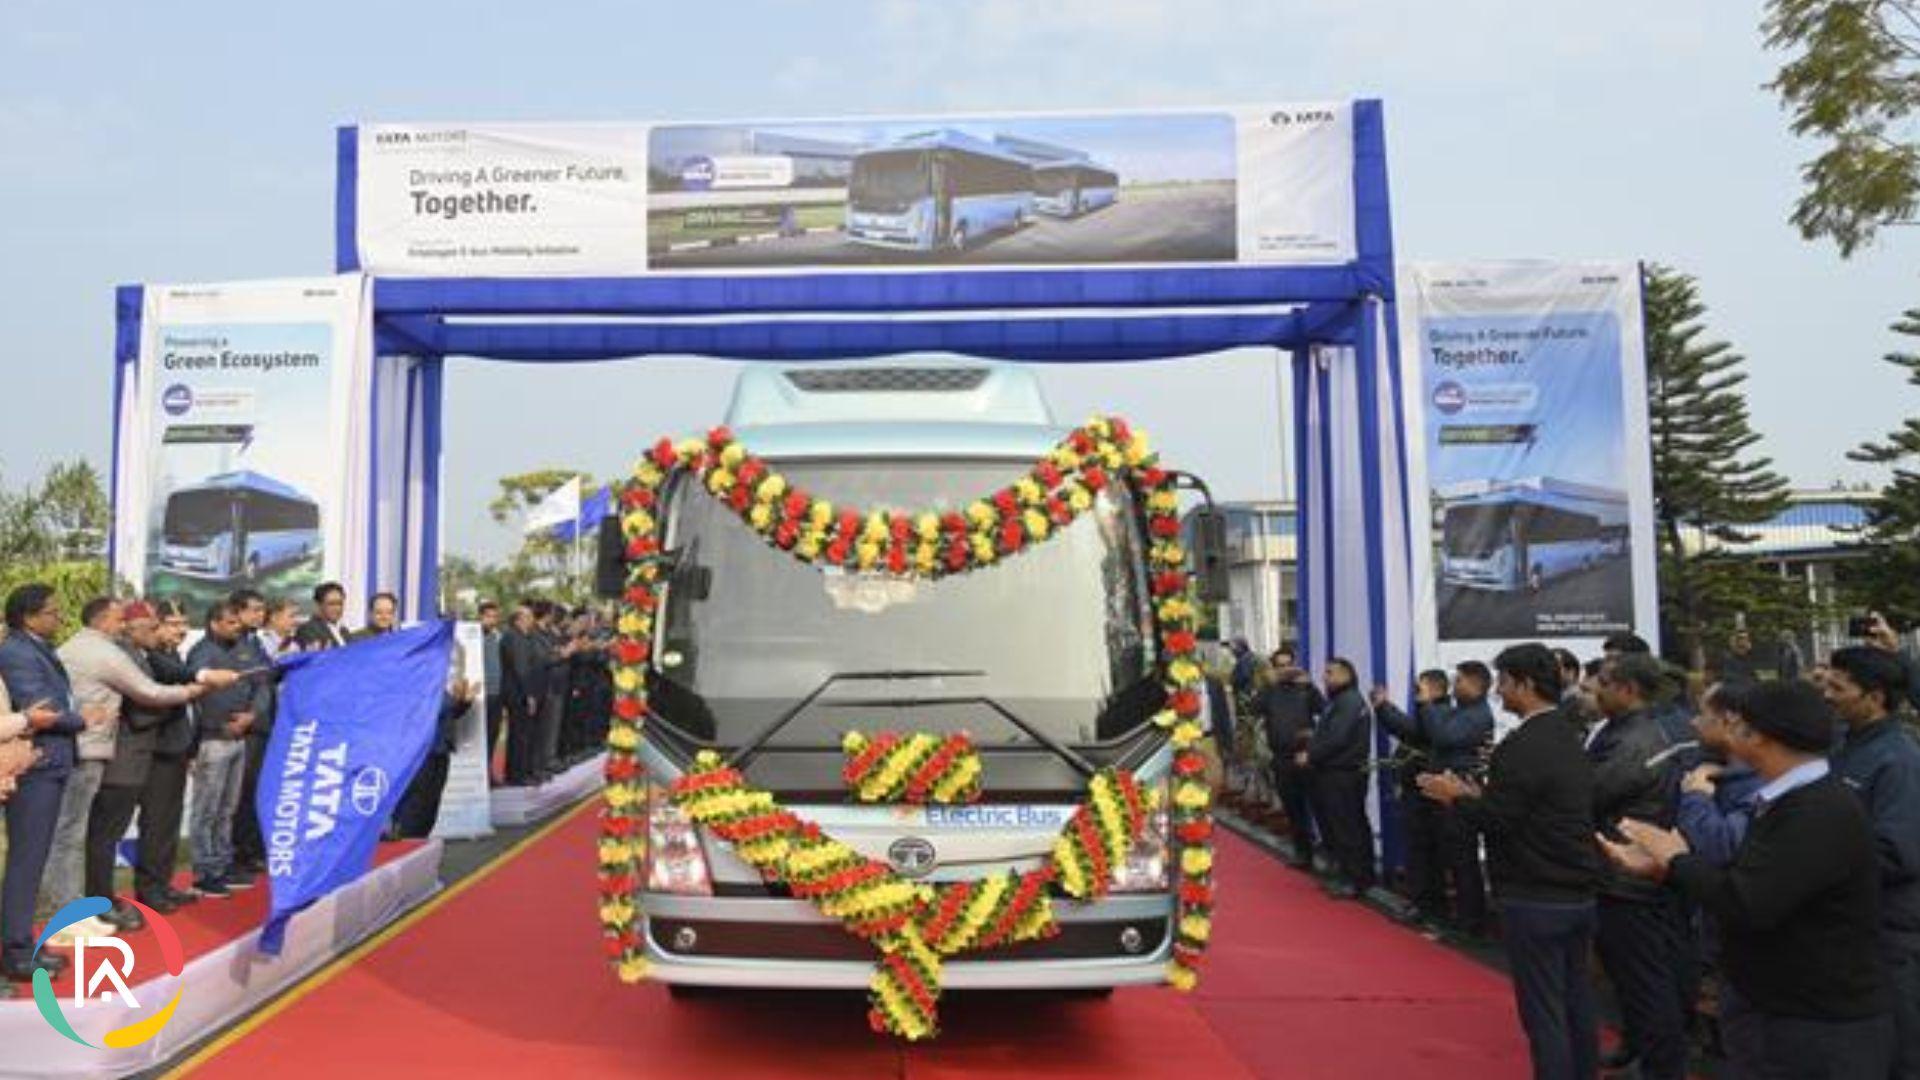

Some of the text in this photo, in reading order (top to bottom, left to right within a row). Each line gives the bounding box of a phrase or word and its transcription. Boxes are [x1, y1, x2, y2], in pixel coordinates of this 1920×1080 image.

[409, 169, 472, 187] Driving
[475, 169, 488, 183] A
[492, 166, 560, 183] Greener
[410, 190, 537, 219] Together.
[164, 350, 319, 372] Green Ecosystem
[1432, 347, 1526, 370] Together.
[268, 719, 319, 876] TATA MOTORS
[306, 742, 347, 841] TATA
[926, 805, 1061, 825] Electric Bus
